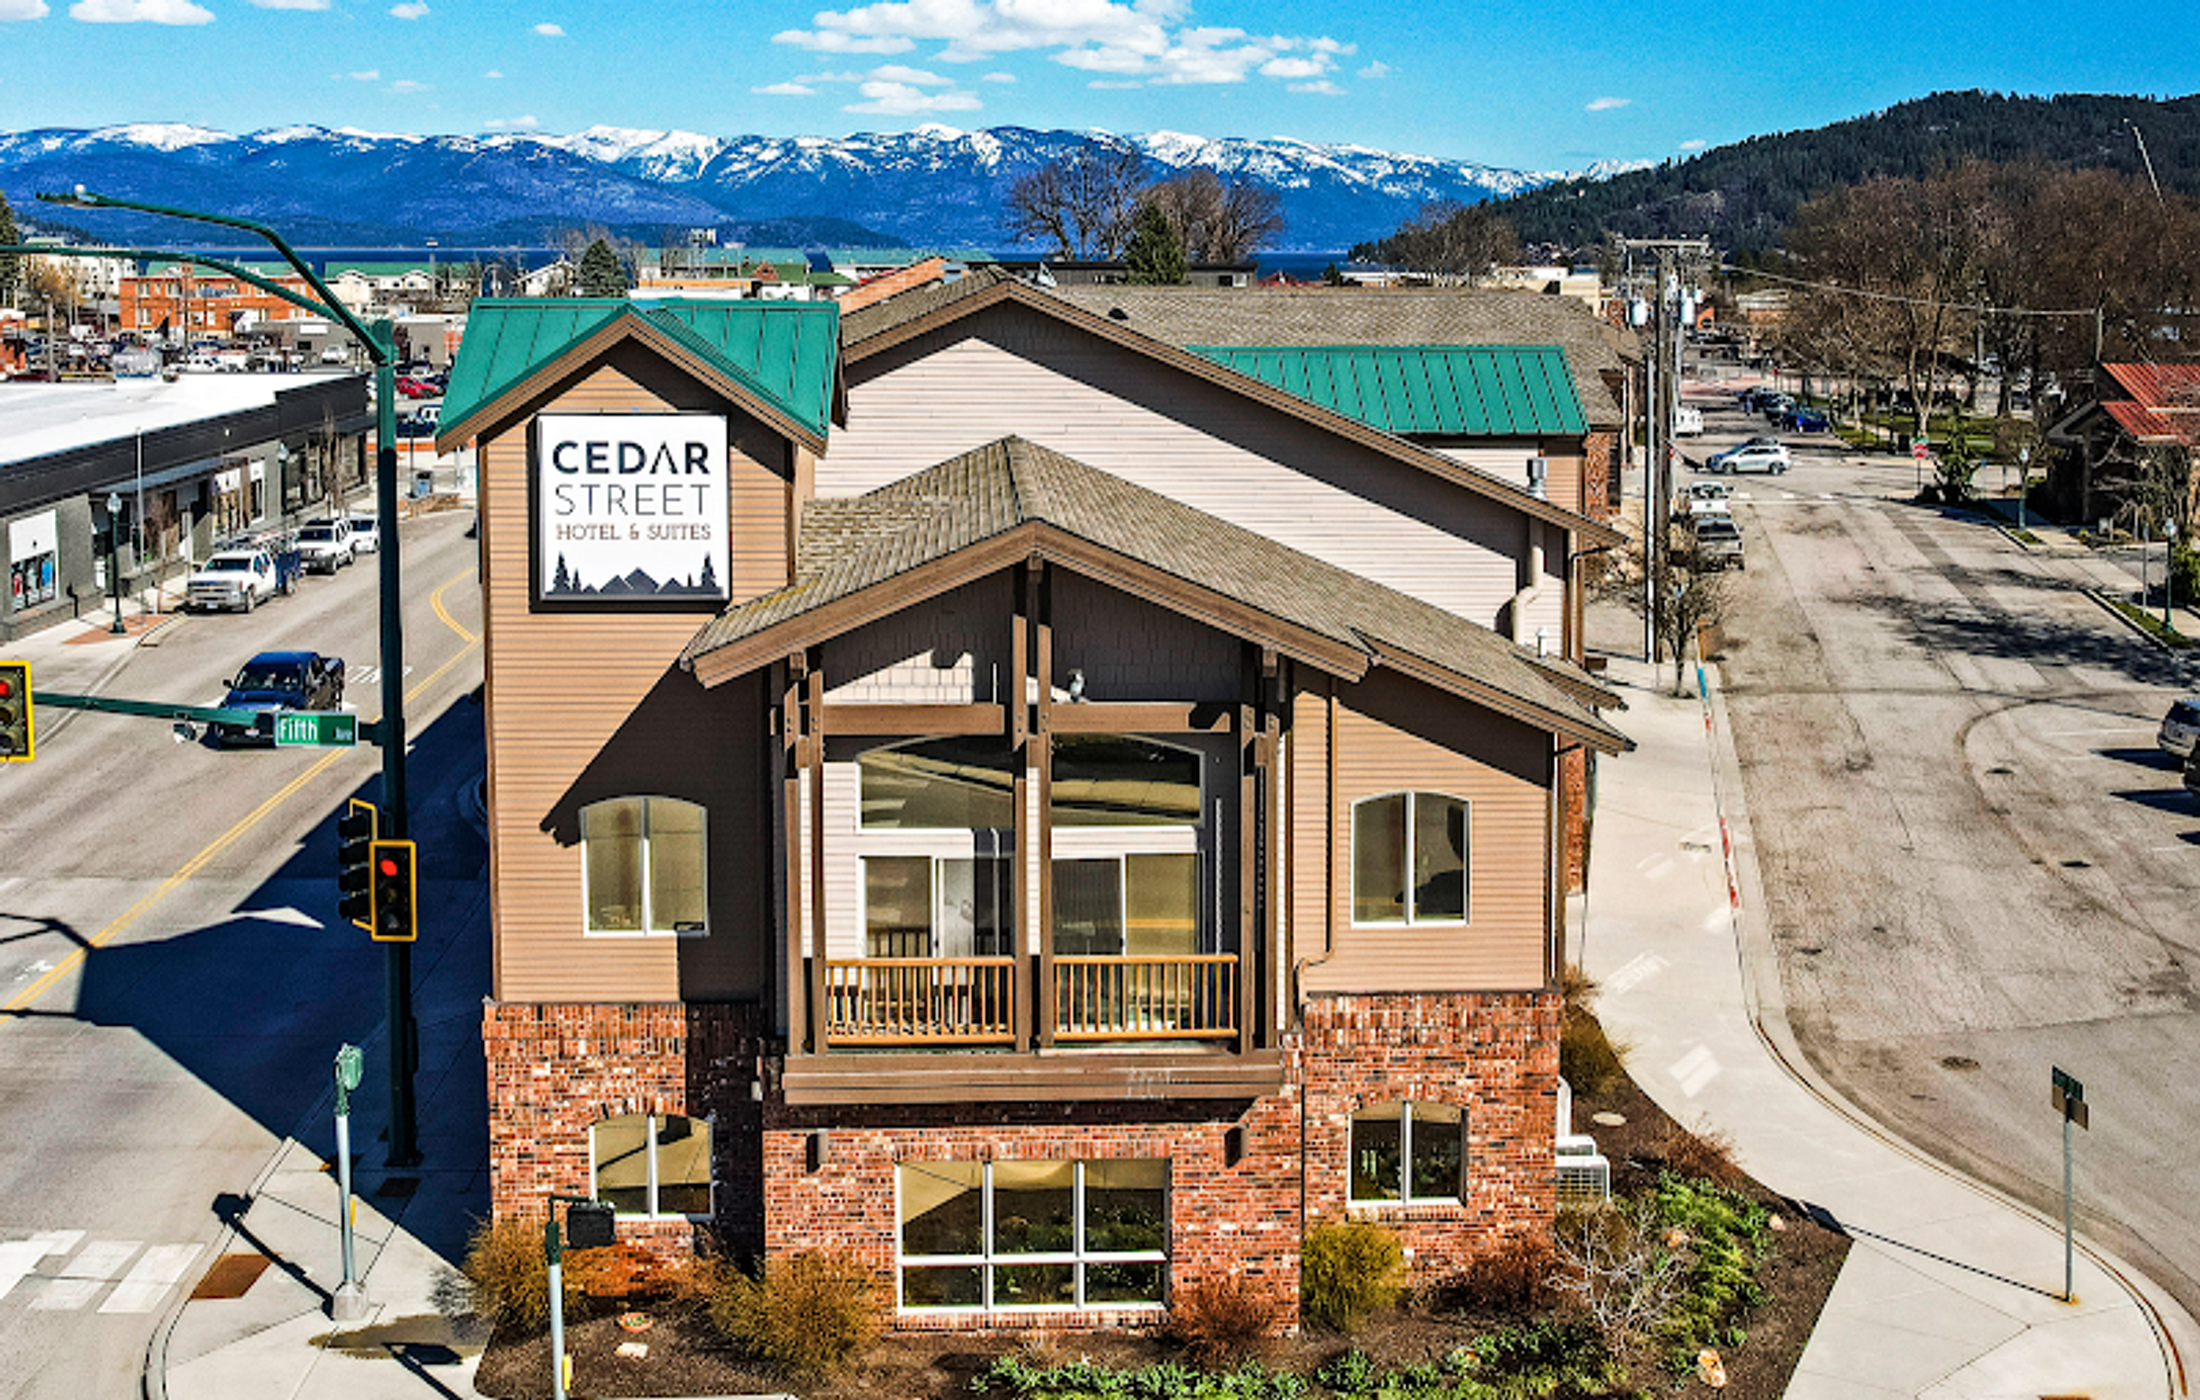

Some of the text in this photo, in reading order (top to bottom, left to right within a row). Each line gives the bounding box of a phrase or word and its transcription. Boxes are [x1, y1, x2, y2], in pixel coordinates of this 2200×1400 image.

[553, 441, 711, 474] CEDAR
[555, 484, 711, 515] STREET
[556, 523, 711, 540] HOTEL & SUITES
[280, 718, 318, 741] Fifth
